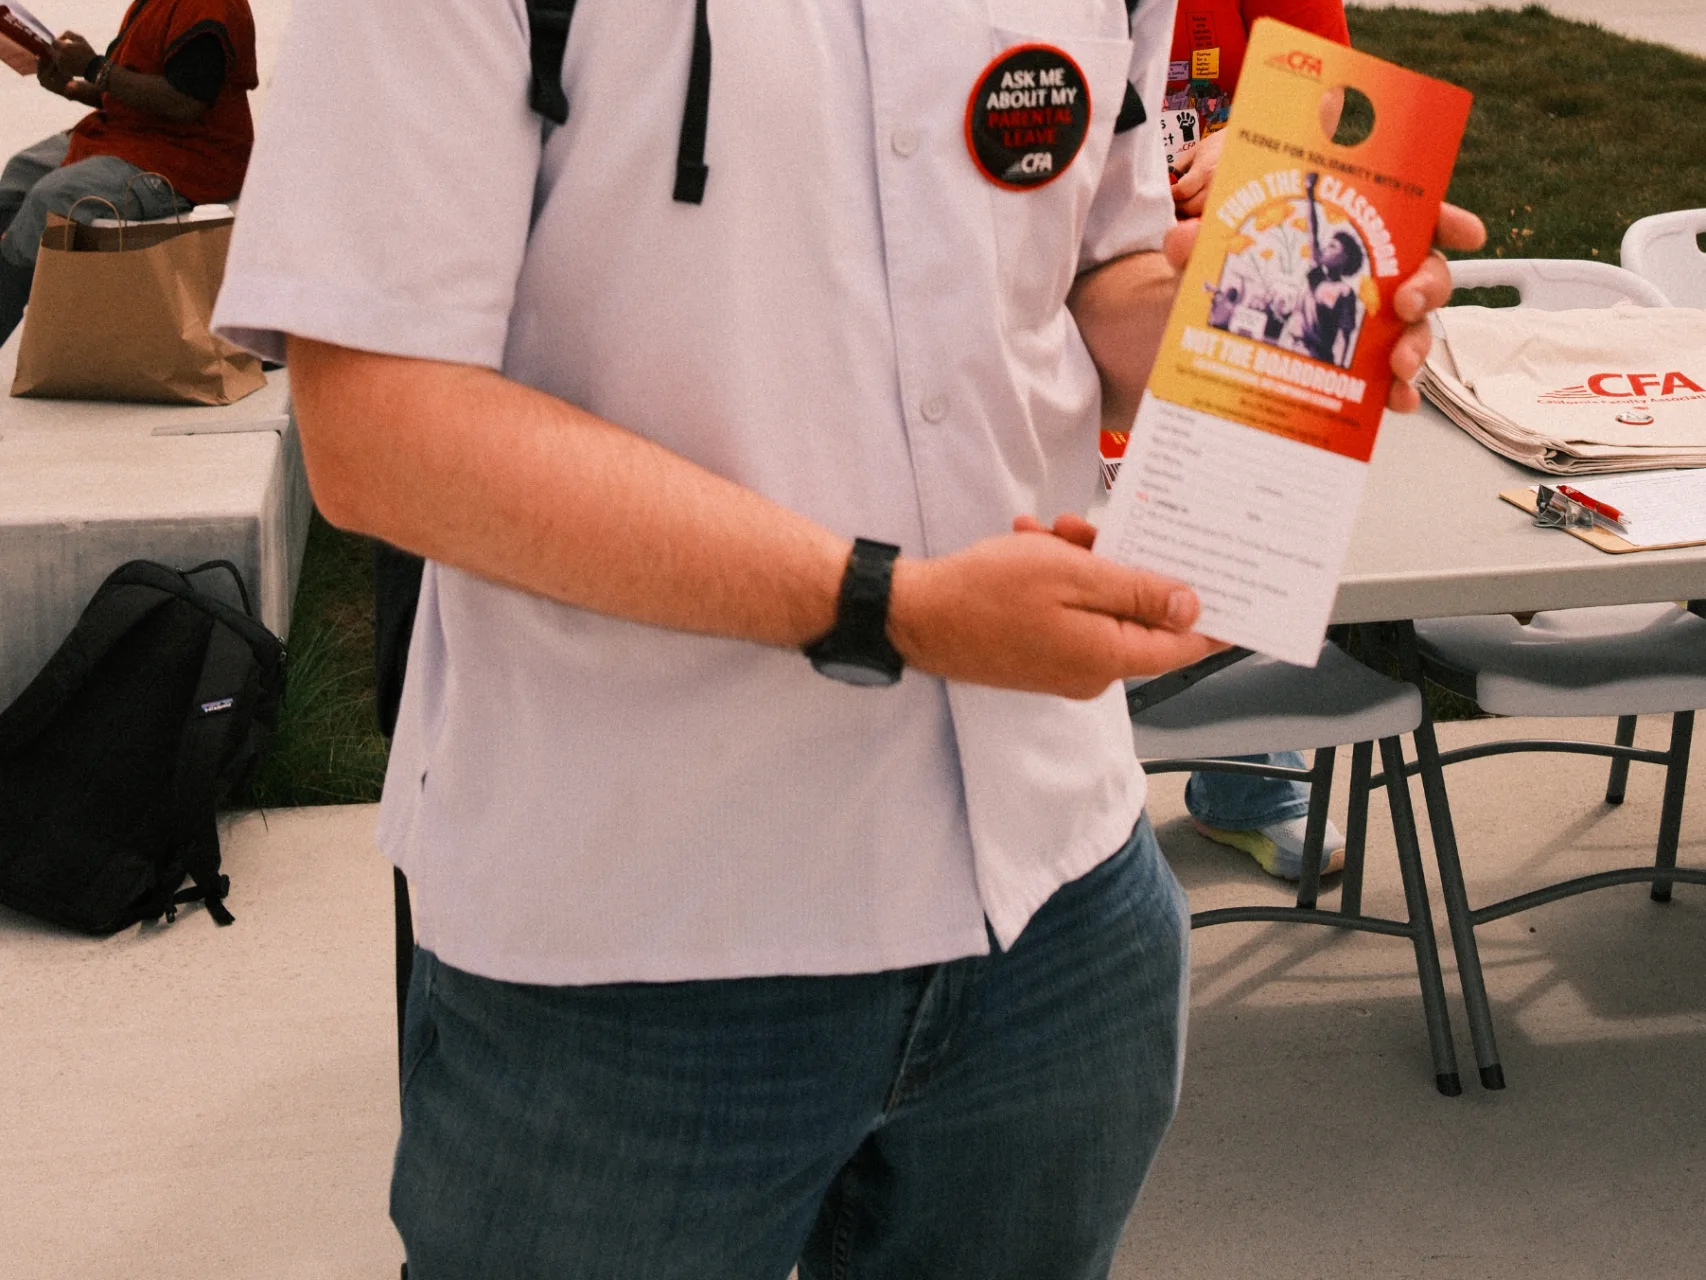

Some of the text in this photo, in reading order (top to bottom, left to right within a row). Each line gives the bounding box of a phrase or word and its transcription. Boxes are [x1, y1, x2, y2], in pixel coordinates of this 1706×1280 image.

[1287, 50, 1323, 77] CFA
[1001, 68, 1065, 90] ASK ME
[986, 87, 1078, 111] ABOUT MY
[987, 106, 1073, 128] PARENTAL
[1003, 127, 1057, 149] LEAVE
[1239, 129, 1282, 154] PLEDGE
[1283, 142, 1305, 158] FOR
[1020, 152, 1053, 174] CFA
[1215, 168, 1400, 278] FUND THE CLASSROOM
[1180, 325, 1220, 357] NOT
[1217, 334, 1255, 370] THE
[1252, 346, 1368, 405] BOARDROOM
[1587, 371, 1706, 397] CFA
